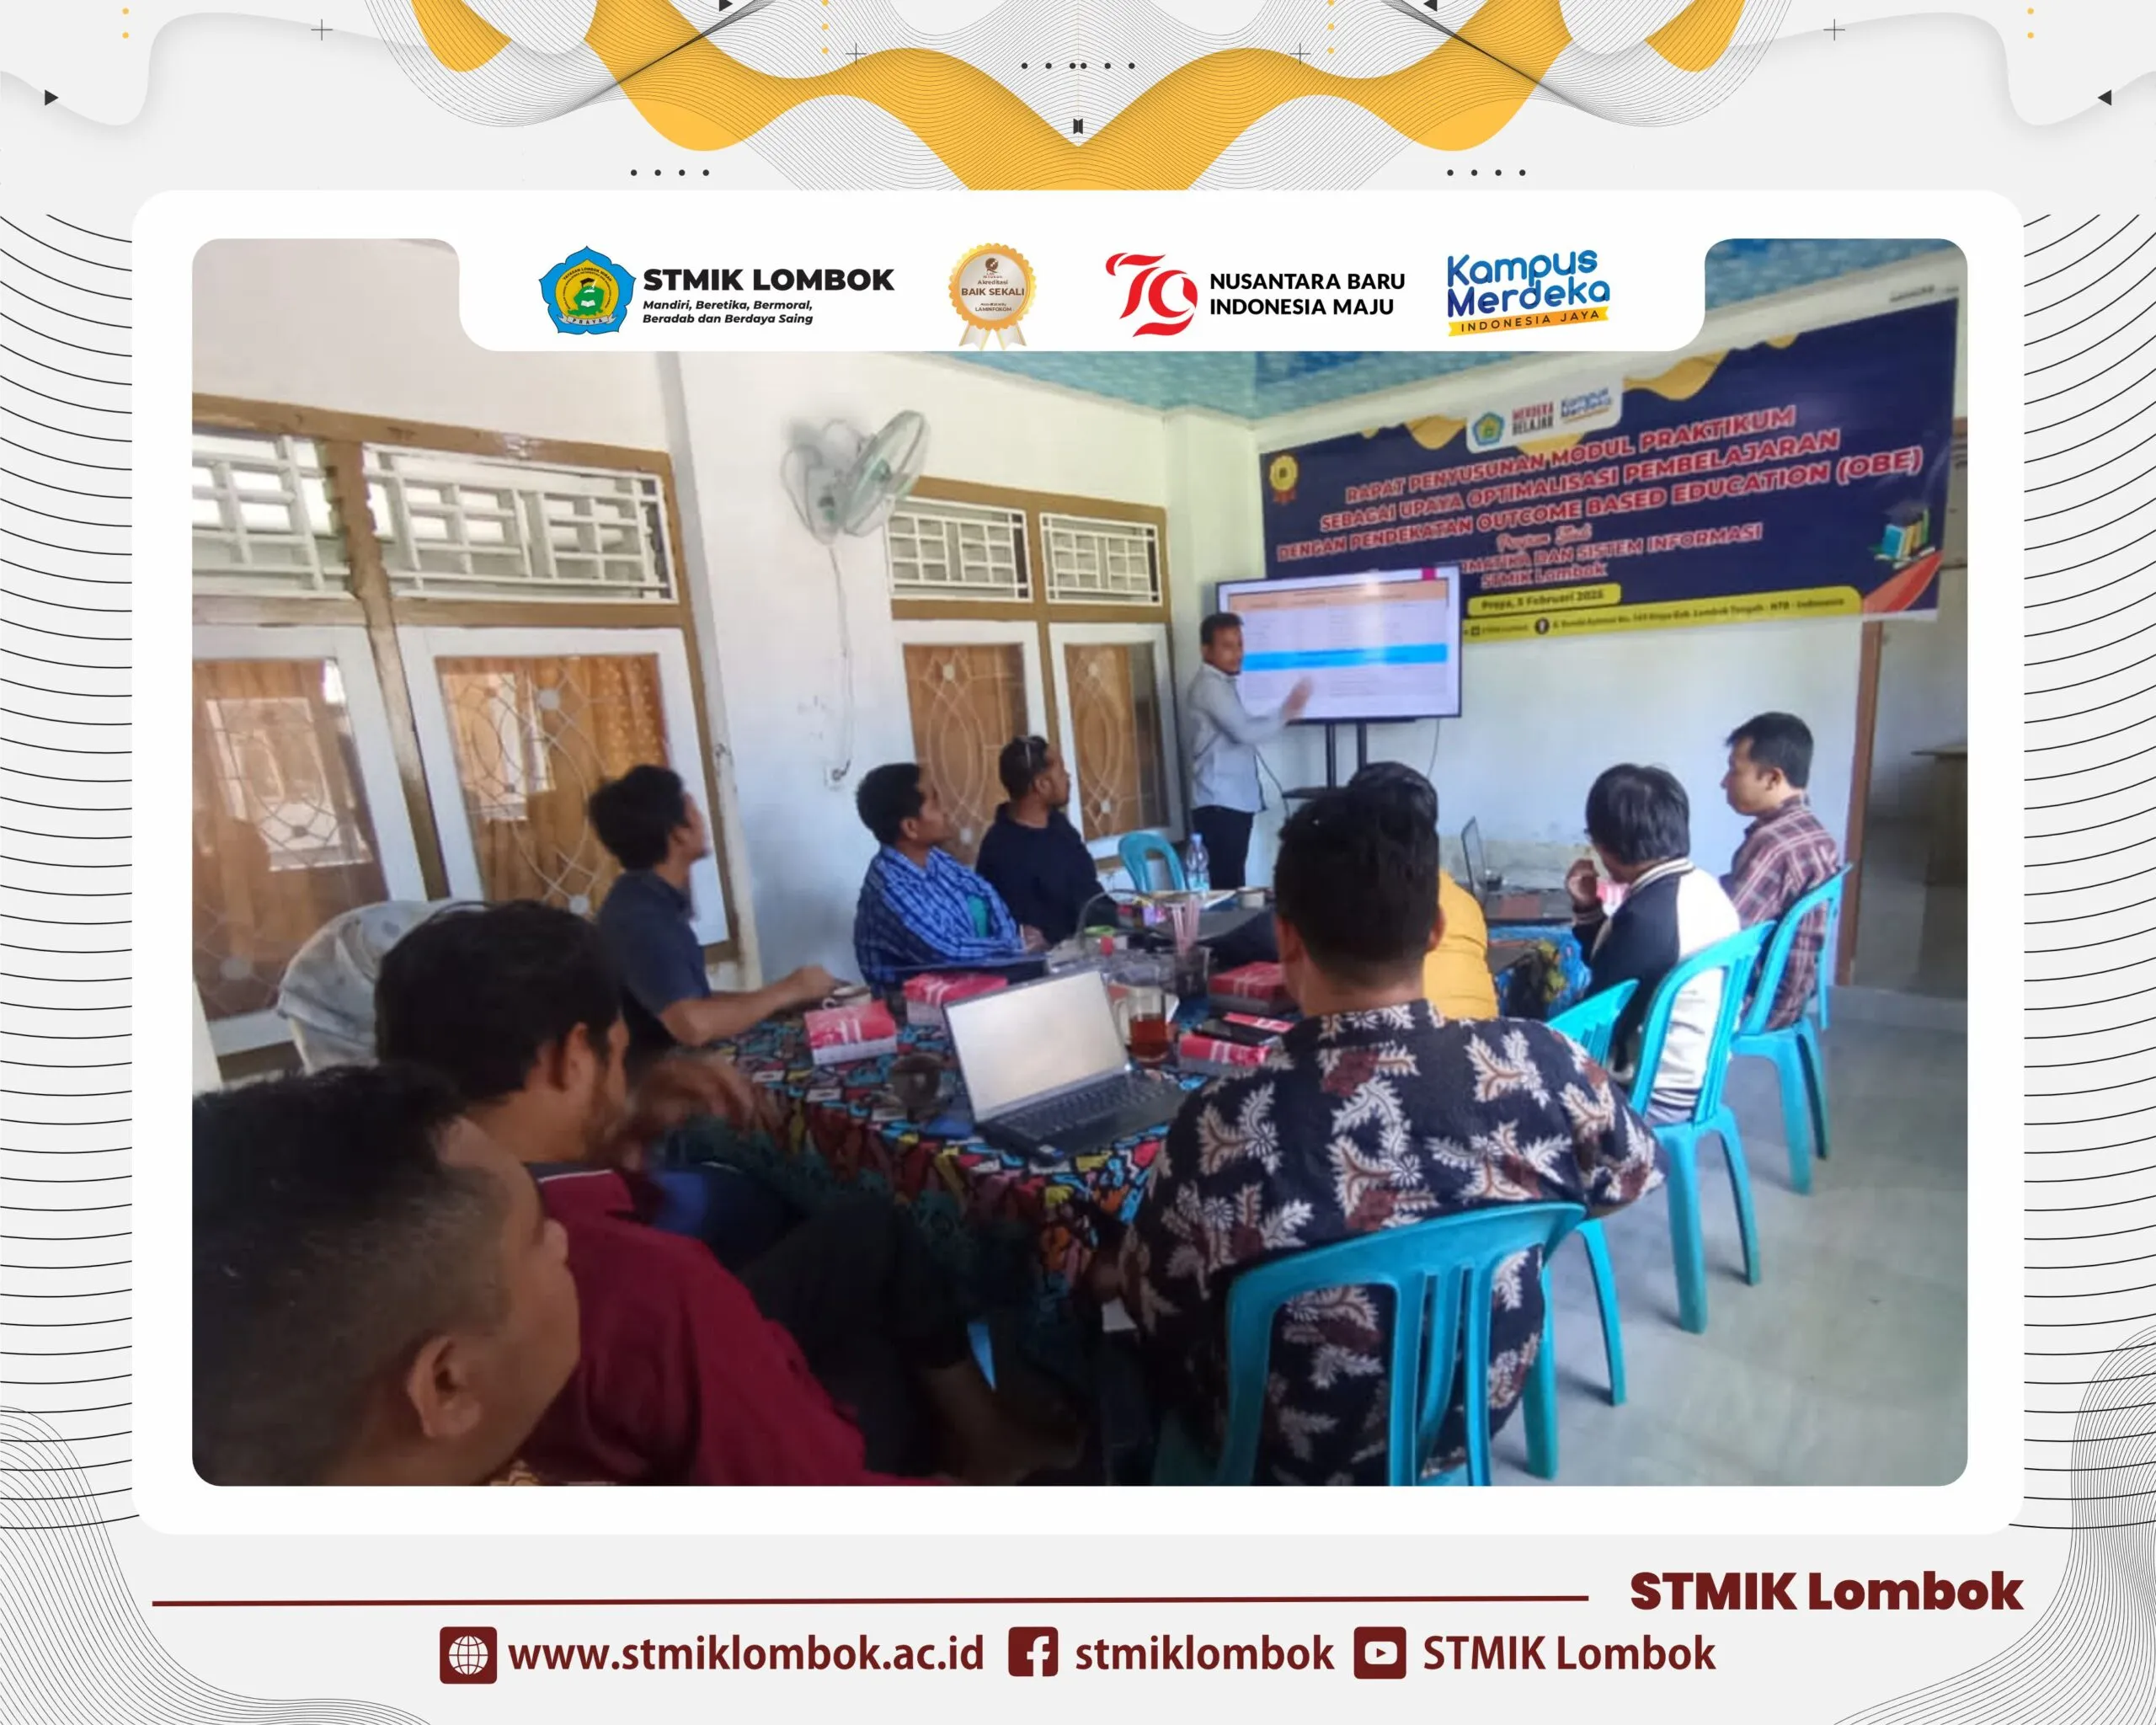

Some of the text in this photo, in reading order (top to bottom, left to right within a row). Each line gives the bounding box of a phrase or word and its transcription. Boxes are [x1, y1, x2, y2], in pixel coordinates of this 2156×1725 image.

[1513, 415, 1555, 435] BELAJAR
[1346, 405, 1796, 504] RAPAT PENYUSUNAN MODUL PRAKTIKUM
[1320, 429, 1841, 532] SEBAGAI UPAYA OPTIMALISASI PEMBELAJARAN
[1277, 446, 1924, 563] DENGAN PENDEKATAN OUTCOME BASED EDUCATION (OBE)
[1533, 546, 1575, 567] DAN
[1576, 537, 1642, 560] SISTEM
[1646, 522, 1764, 553] INFORMASI
[1481, 560, 1609, 589] STMIK Lombok
[1526, 593, 1575, 606] Februari
